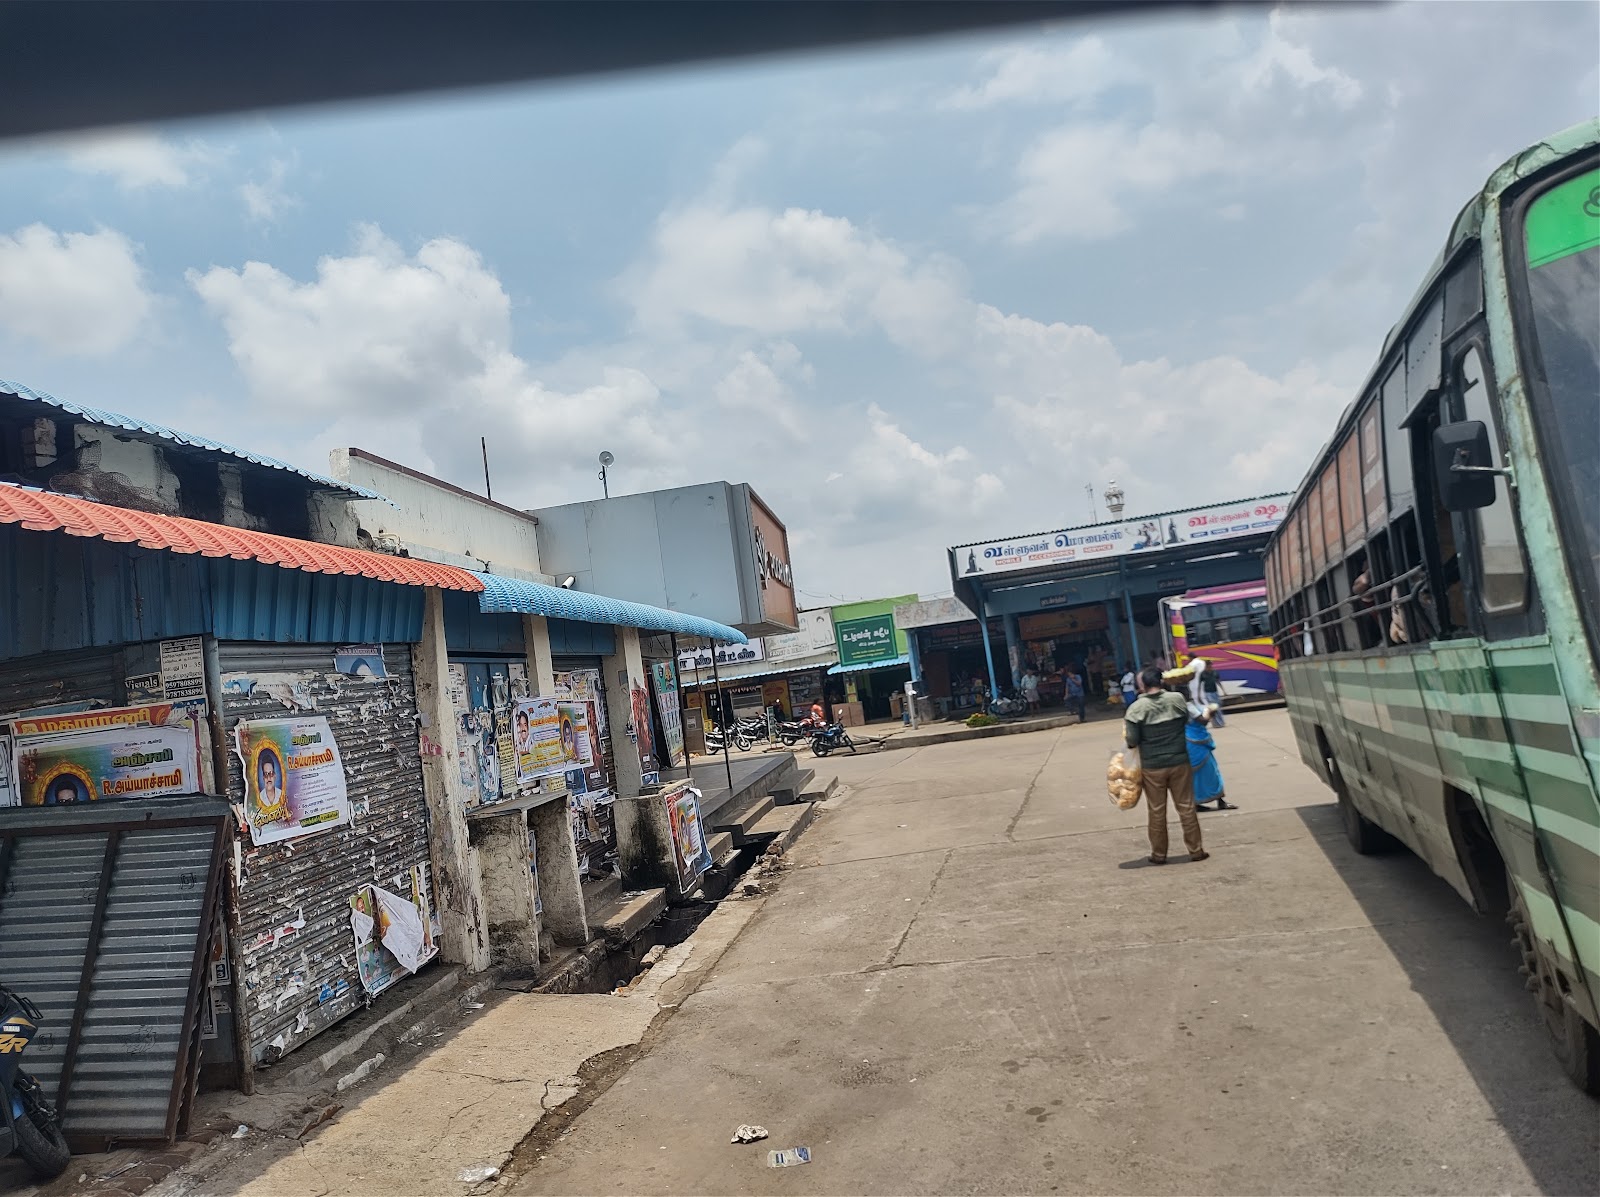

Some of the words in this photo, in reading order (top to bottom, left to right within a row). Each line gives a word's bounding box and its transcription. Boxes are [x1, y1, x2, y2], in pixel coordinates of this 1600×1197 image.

[984, 540, 1050, 558] வள்ளுவன்
[1055, 528, 1123, 547] மொபைல்ஸ்
[843, 629, 871, 642] உழவன்
[103, 768, 182, 795] R.அய்யாச்சாமி
